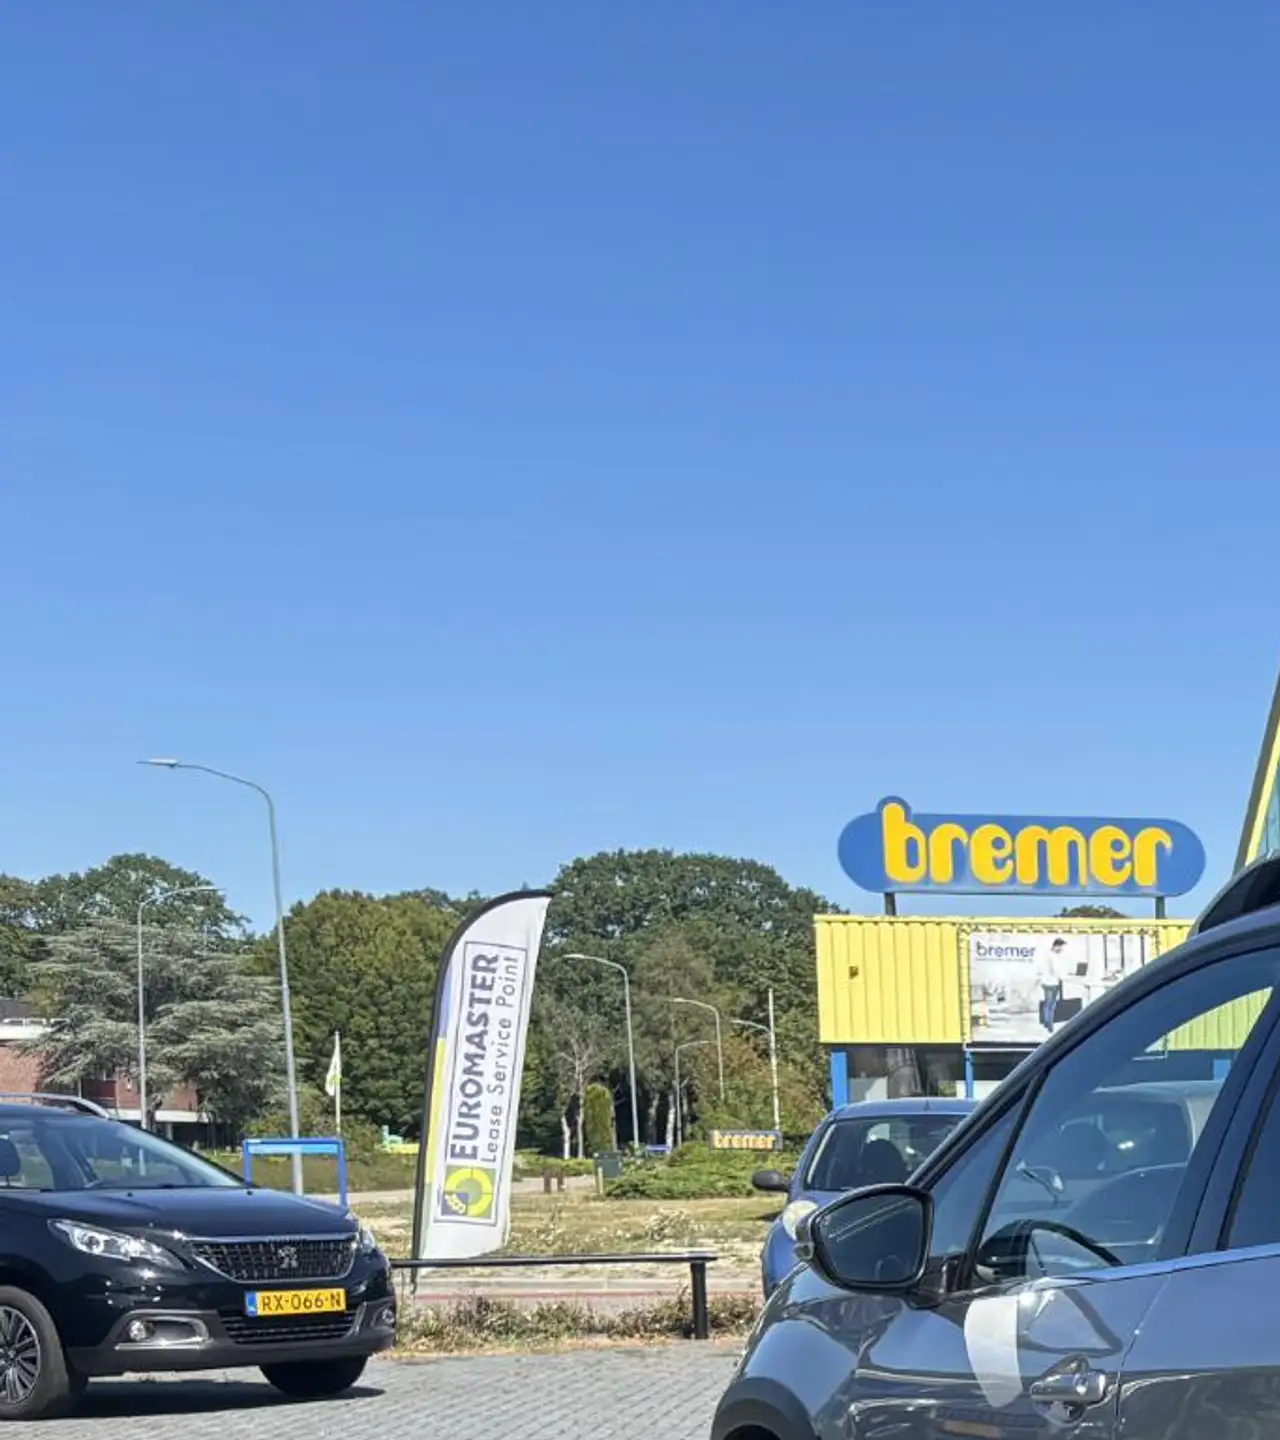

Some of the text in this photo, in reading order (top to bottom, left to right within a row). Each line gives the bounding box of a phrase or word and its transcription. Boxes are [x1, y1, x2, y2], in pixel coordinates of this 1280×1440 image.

[881, 801, 1173, 887] bremer
[975, 940, 1037, 958] bremer
[450, 953, 499, 1161] EUROMASTER
[479, 954, 519, 1163] Lease Service Point
[713, 1129, 777, 1150] bremer
[261, 1292, 341, 1312] RX-066-N
